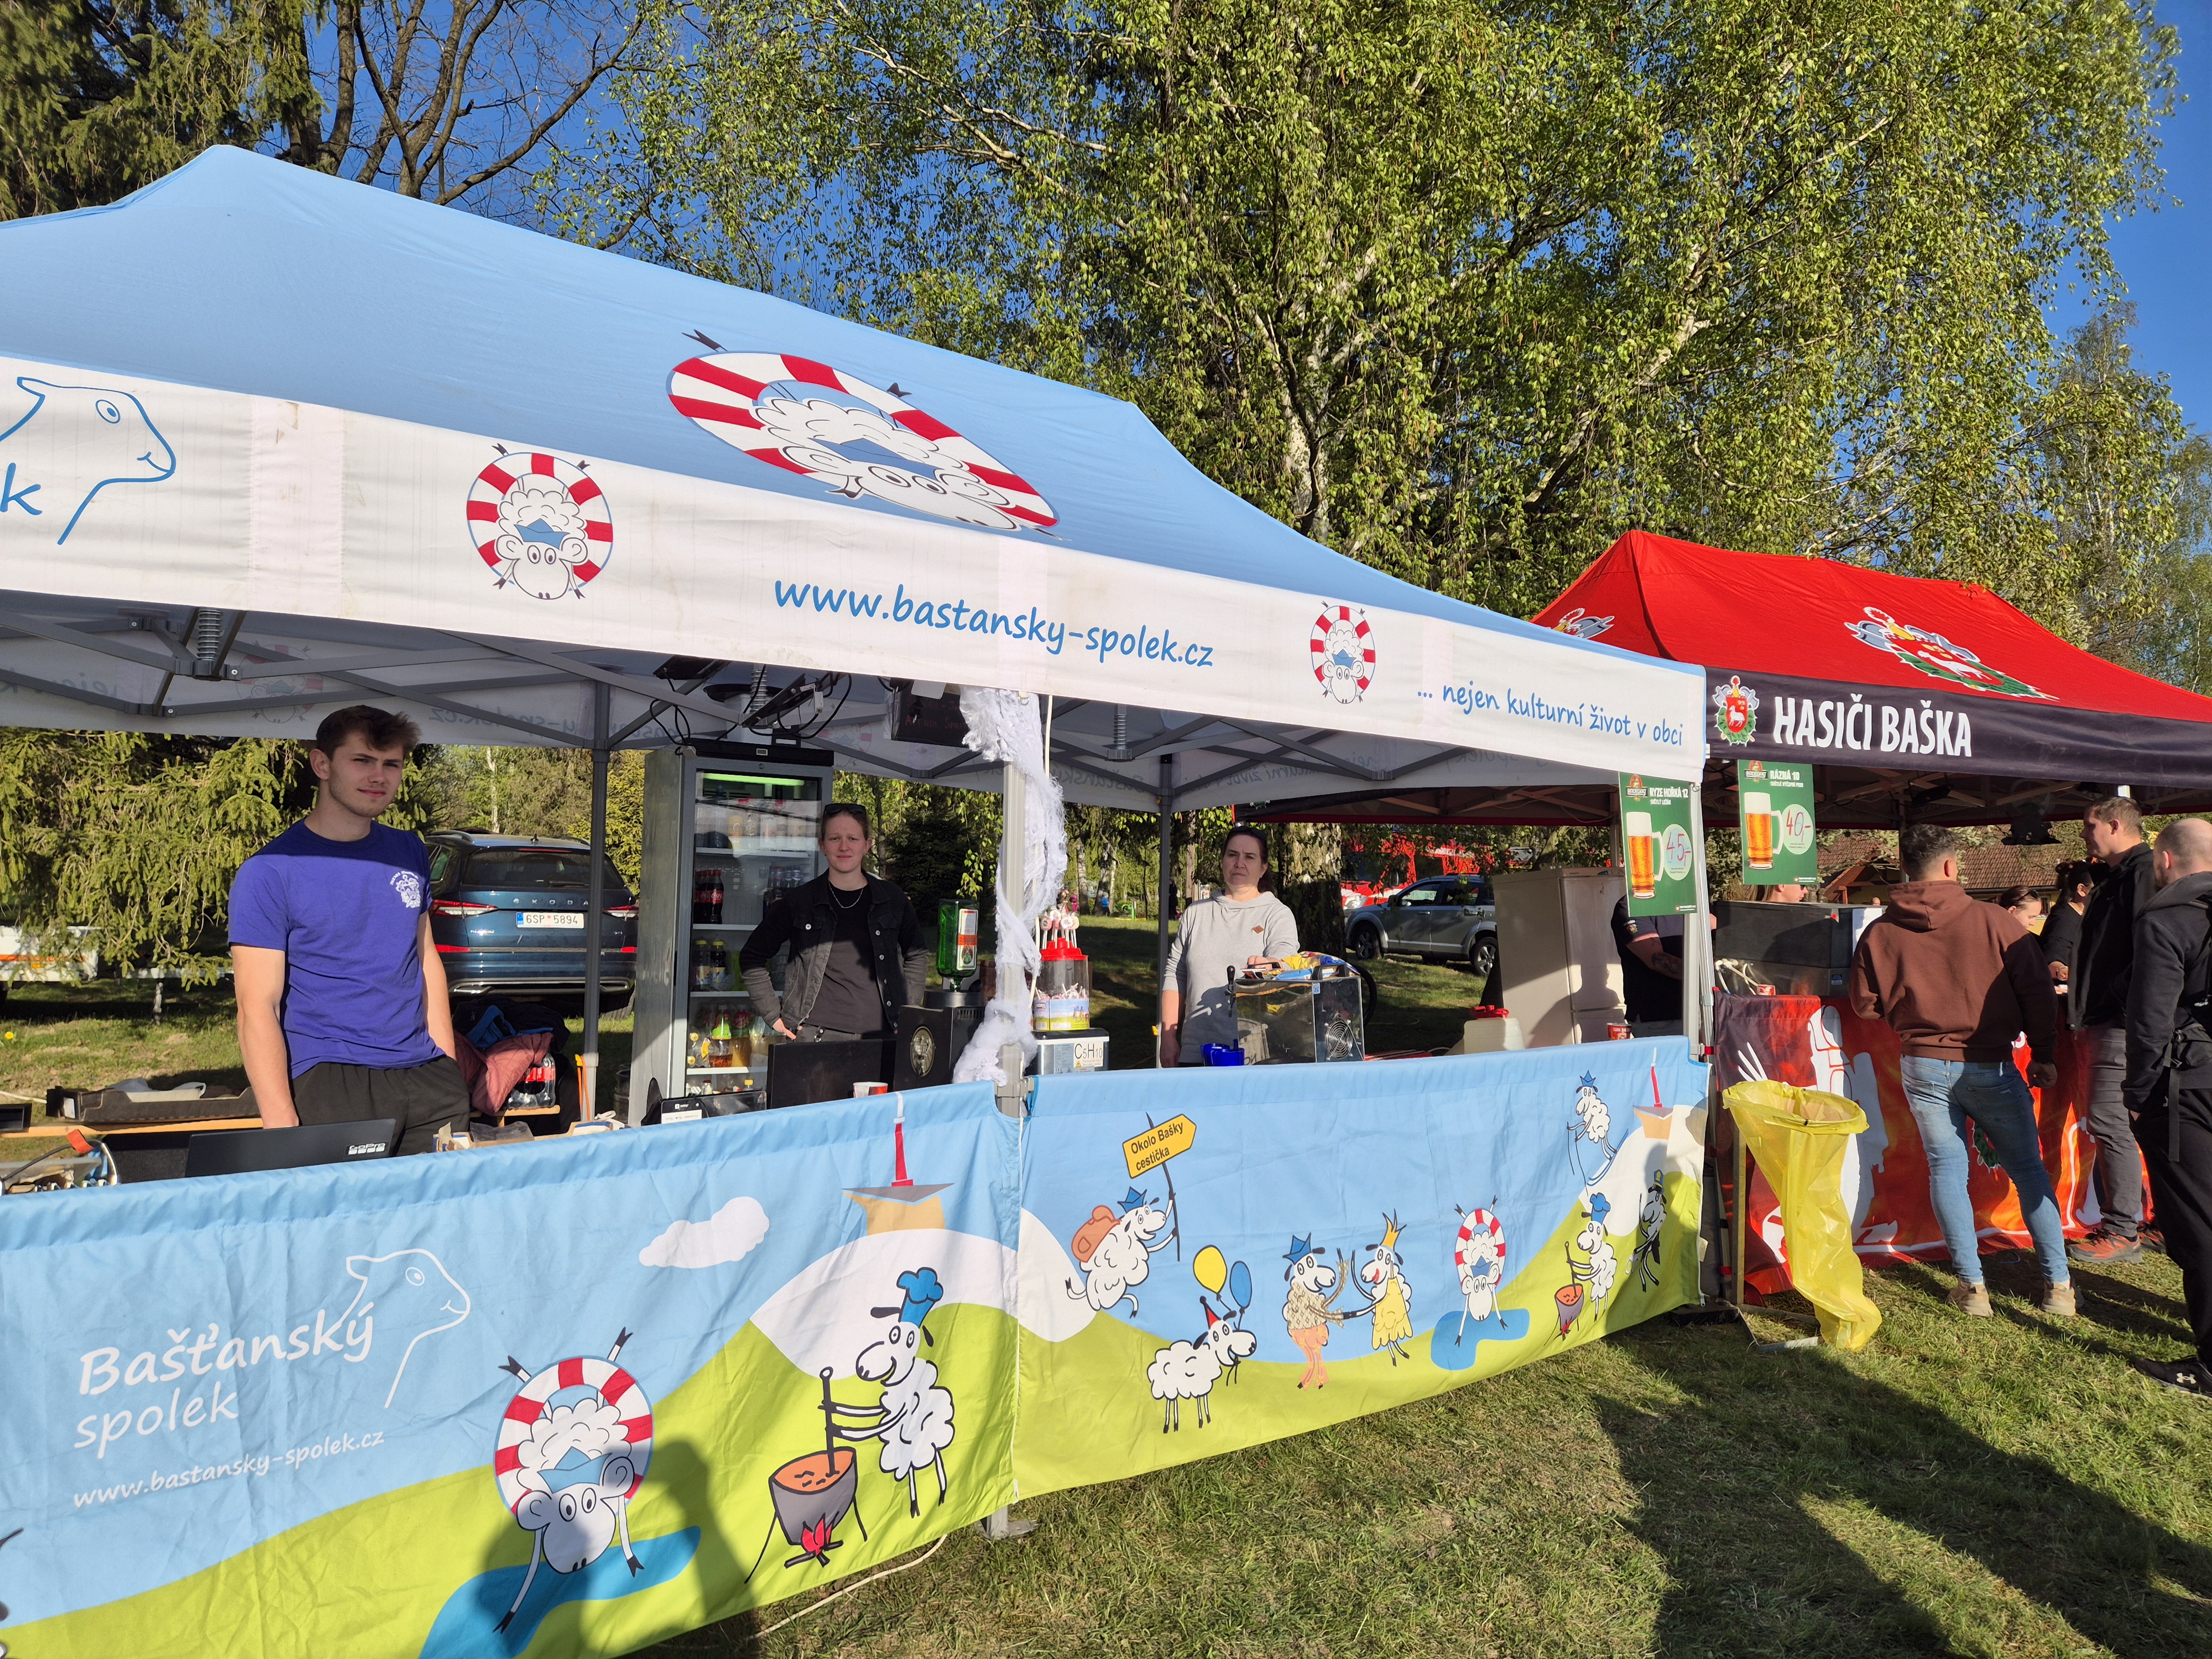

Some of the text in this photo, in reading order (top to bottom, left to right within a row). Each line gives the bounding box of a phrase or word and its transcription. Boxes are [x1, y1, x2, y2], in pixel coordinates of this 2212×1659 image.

[775, 580, 1213, 667] www.bastansky-spolek.cz
[1443, 680, 1500, 714] nejen
[1507, 688, 1585, 727] kulturní
[1590, 705, 1631, 736] život
[1637, 722, 1647, 738] v
[1653, 718, 1683, 746] obci
[1773, 693, 1972, 757] HASIČI BAŠKA
[1650, 786, 1689, 798] RYZE HOŘKÁ 12
[1770, 769, 1800, 781] RÁZNÁ 10
[526, 915, 545, 924] 6SP
[554, 915, 578, 925] 5894
[348, 1142, 386, 1152] GoPro
[1131, 1122, 1183, 1154] Okolo Bašky
[1136, 1147, 1170, 1171] cestička
[79, 1302, 374, 1396] Bašťanský
[74, 1381, 238, 1459] spolek
[73, 1429, 385, 1509] www.bastansky-spolek.cz
